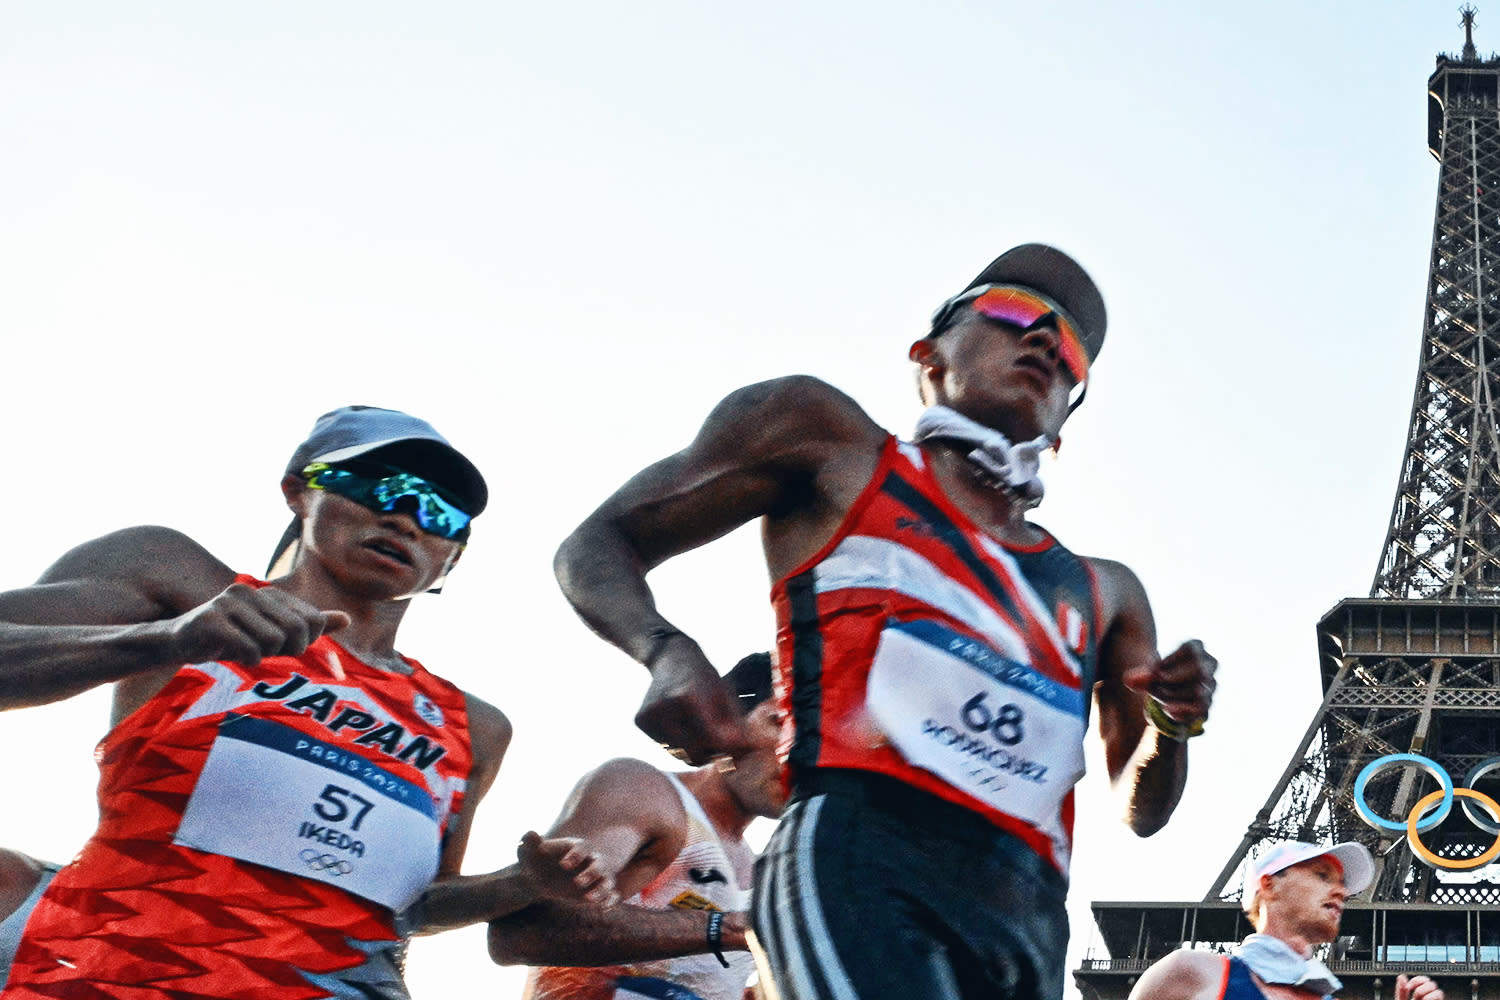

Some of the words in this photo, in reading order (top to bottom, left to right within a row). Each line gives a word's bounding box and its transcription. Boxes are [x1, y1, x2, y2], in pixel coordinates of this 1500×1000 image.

[252, 672, 447, 771] JAPAN
[959, 691, 1024, 746] 68
[313, 783, 375, 832] 57
[298, 821, 366, 858] IKEDA
